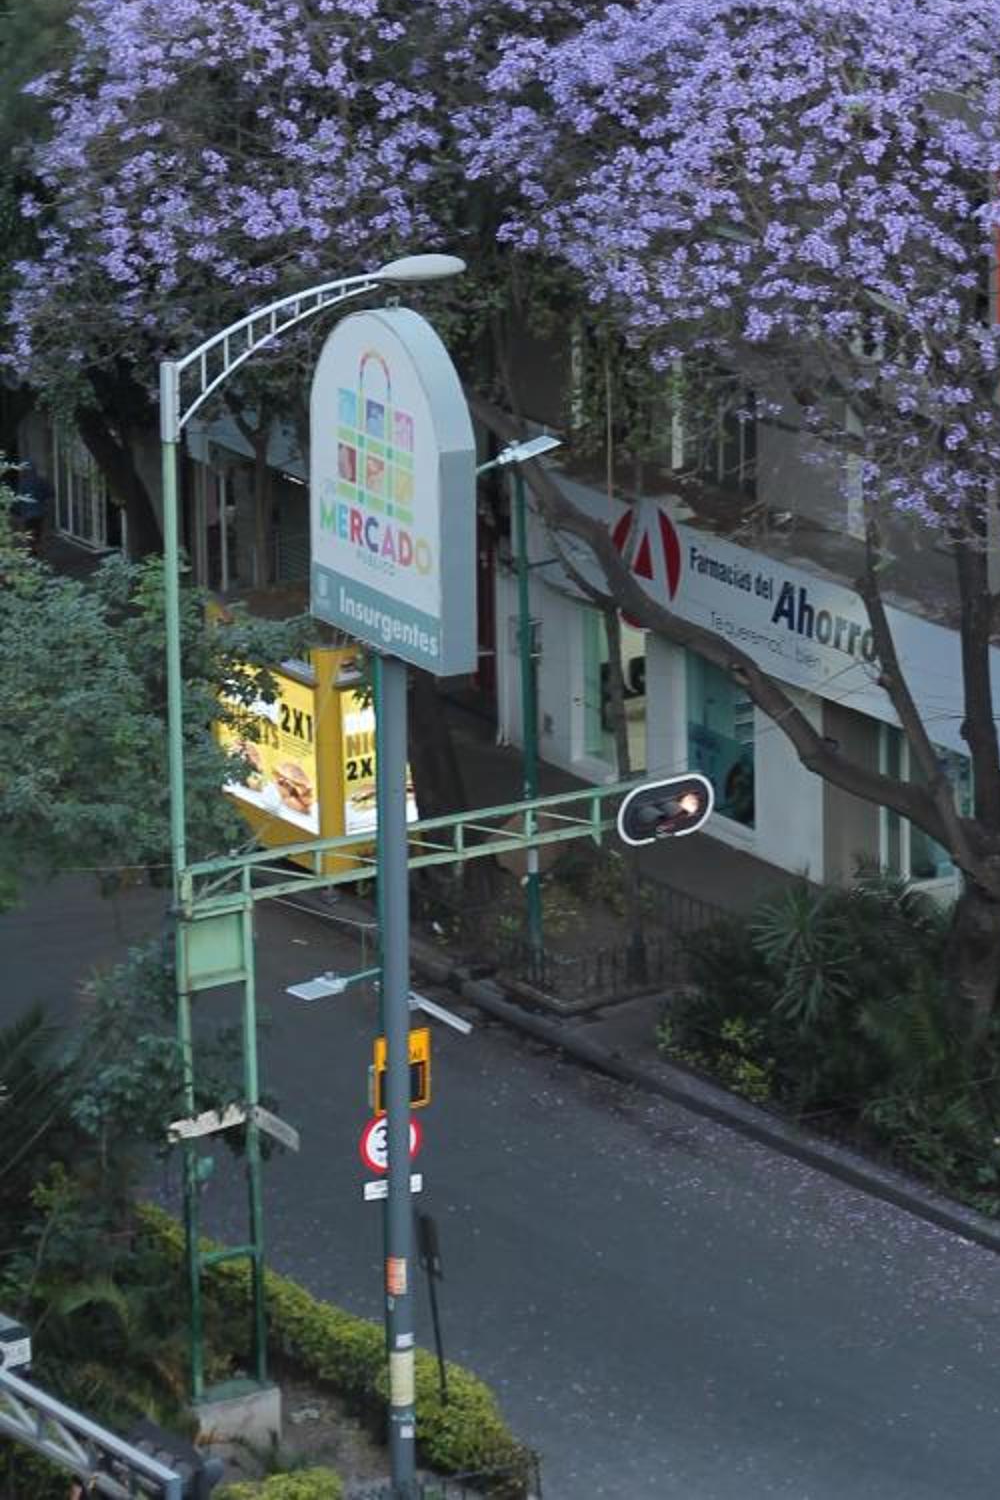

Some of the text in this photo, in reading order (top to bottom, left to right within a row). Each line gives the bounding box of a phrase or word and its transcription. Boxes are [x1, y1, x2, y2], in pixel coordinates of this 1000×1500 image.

[320, 496, 432, 576] MERCADO
[340, 587, 438, 656] Insurgentes
[689, 546, 878, 663] Farmacias del Ahorro
[281, 703, 313, 743] 2X1
[346, 757, 374, 781] 2X
